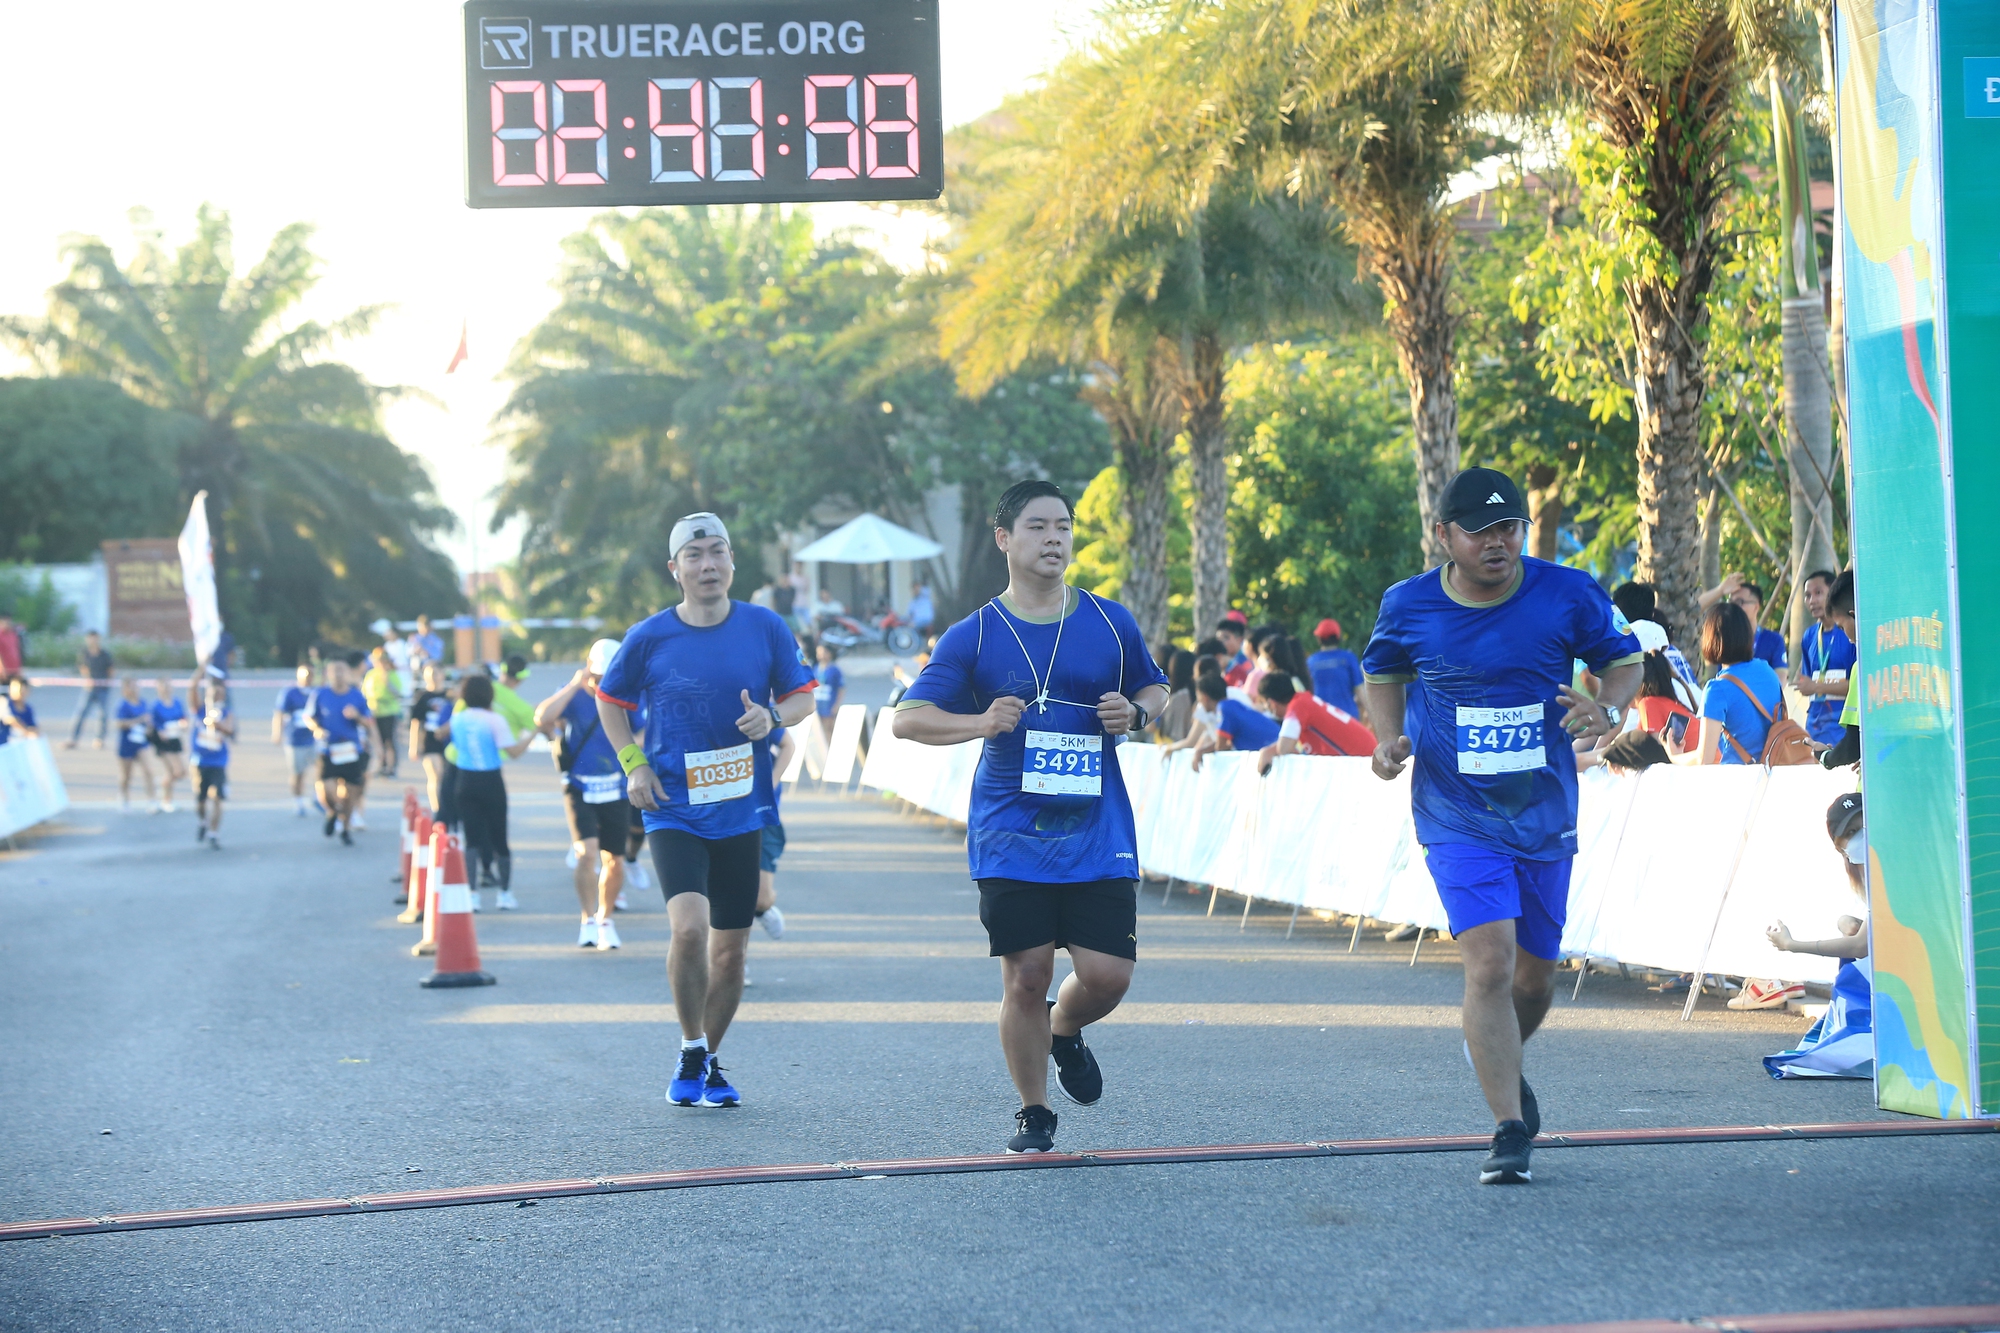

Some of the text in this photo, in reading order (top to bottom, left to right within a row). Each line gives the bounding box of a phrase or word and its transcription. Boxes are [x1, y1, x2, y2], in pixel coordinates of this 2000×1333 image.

[541, 21, 866, 59] TRUERACE.ORG
[490, 74, 920, 187] 02:41:58
[1876, 609, 1943, 655] PHAN THIẾT
[1867, 663, 1951, 714] MARATHON
[1493, 710, 1523, 722] 5KM
[1060, 736, 1086, 748] 5KM
[1467, 726, 1532, 749] 5479
[715, 750, 738, 761] 10KM
[1033, 751, 1091, 773] 5491
[693, 761, 747, 785] 10332
